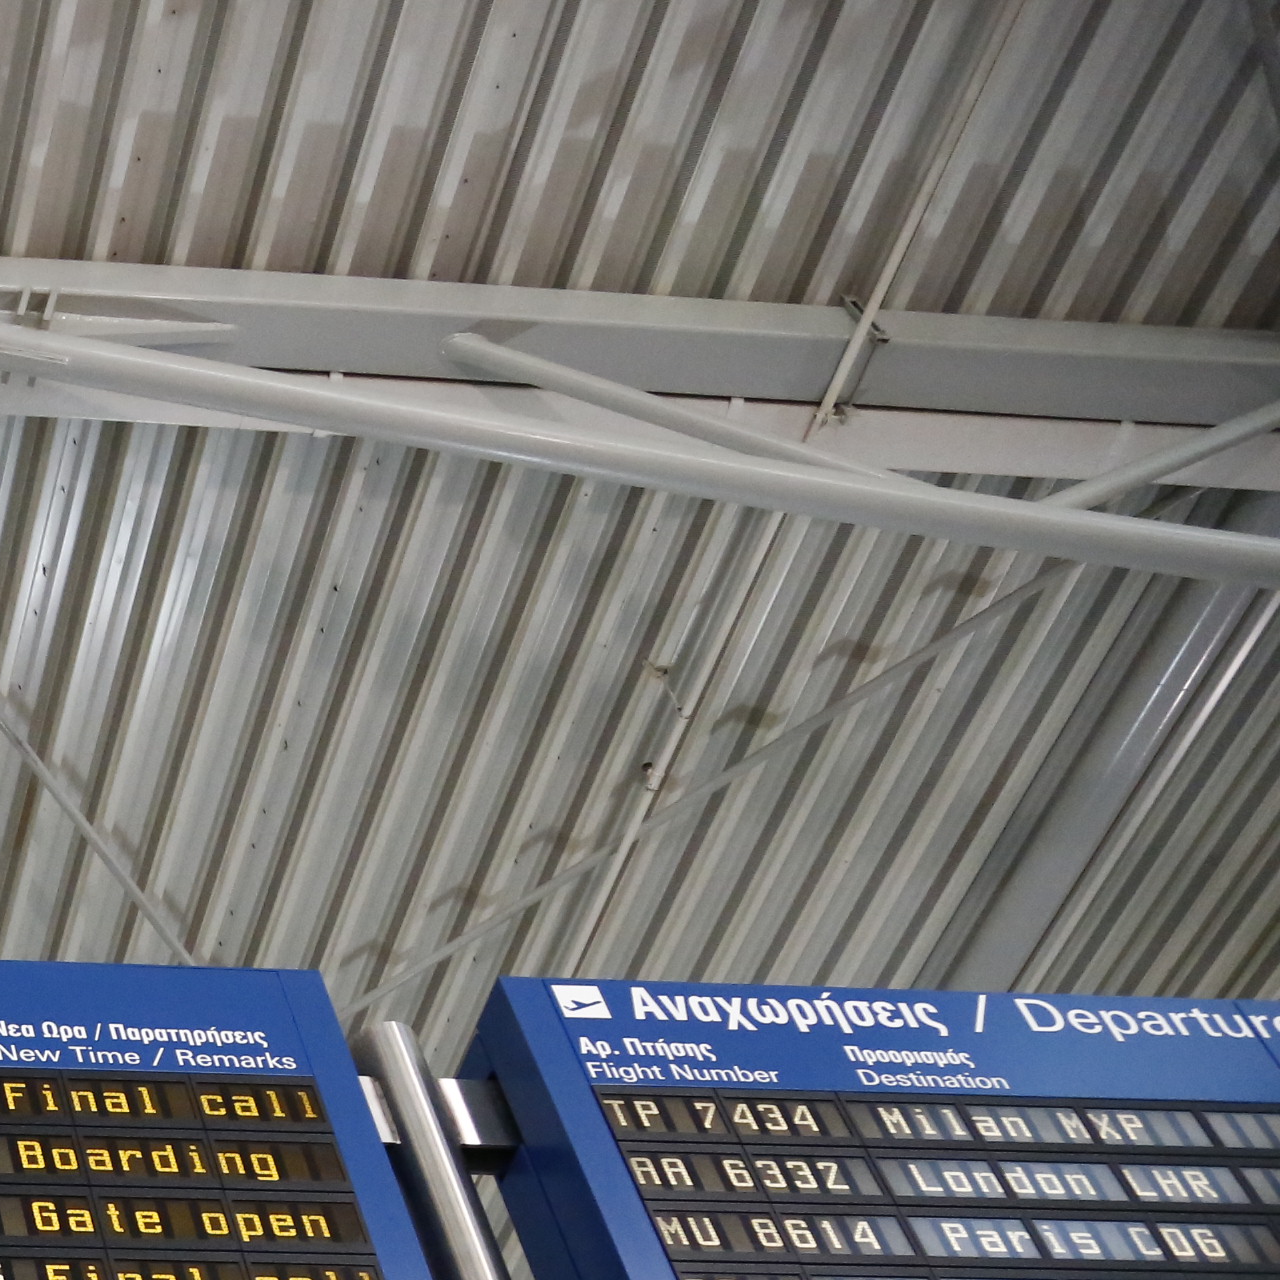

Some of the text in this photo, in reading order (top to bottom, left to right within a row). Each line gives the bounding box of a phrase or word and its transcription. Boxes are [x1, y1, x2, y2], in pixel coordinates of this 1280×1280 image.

[630, 987, 949, 1037] Αναχωρήσεις
[42, 1022, 88, 1041] Ωρα
[109, 1024, 268, 1048] Παρατηρήσεις
[578, 1037, 717, 1061] Αρ. Πτήσης
[68, 1046, 140, 1065] Time
[175, 1049, 297, 1069] Remarks
[587, 1061, 779, 1083] Flight Number
[843, 1045, 976, 1068] Προορισμός
[855, 1069, 1011, 1090] Destination
[4, 1083, 156, 1113] Final
[200, 1091, 317, 1117] call
[603, 1100, 1143, 1143] TP 7434 Milan MXP
[17, 1141, 279, 1181] Boarding
[630, 1158, 1219, 1199] AA 6332 London LHR
[32, 1202, 162, 1233] Gate
[202, 1213, 330, 1241] open
[656, 1217, 1226, 1260] MU 8614 Paris CDG
